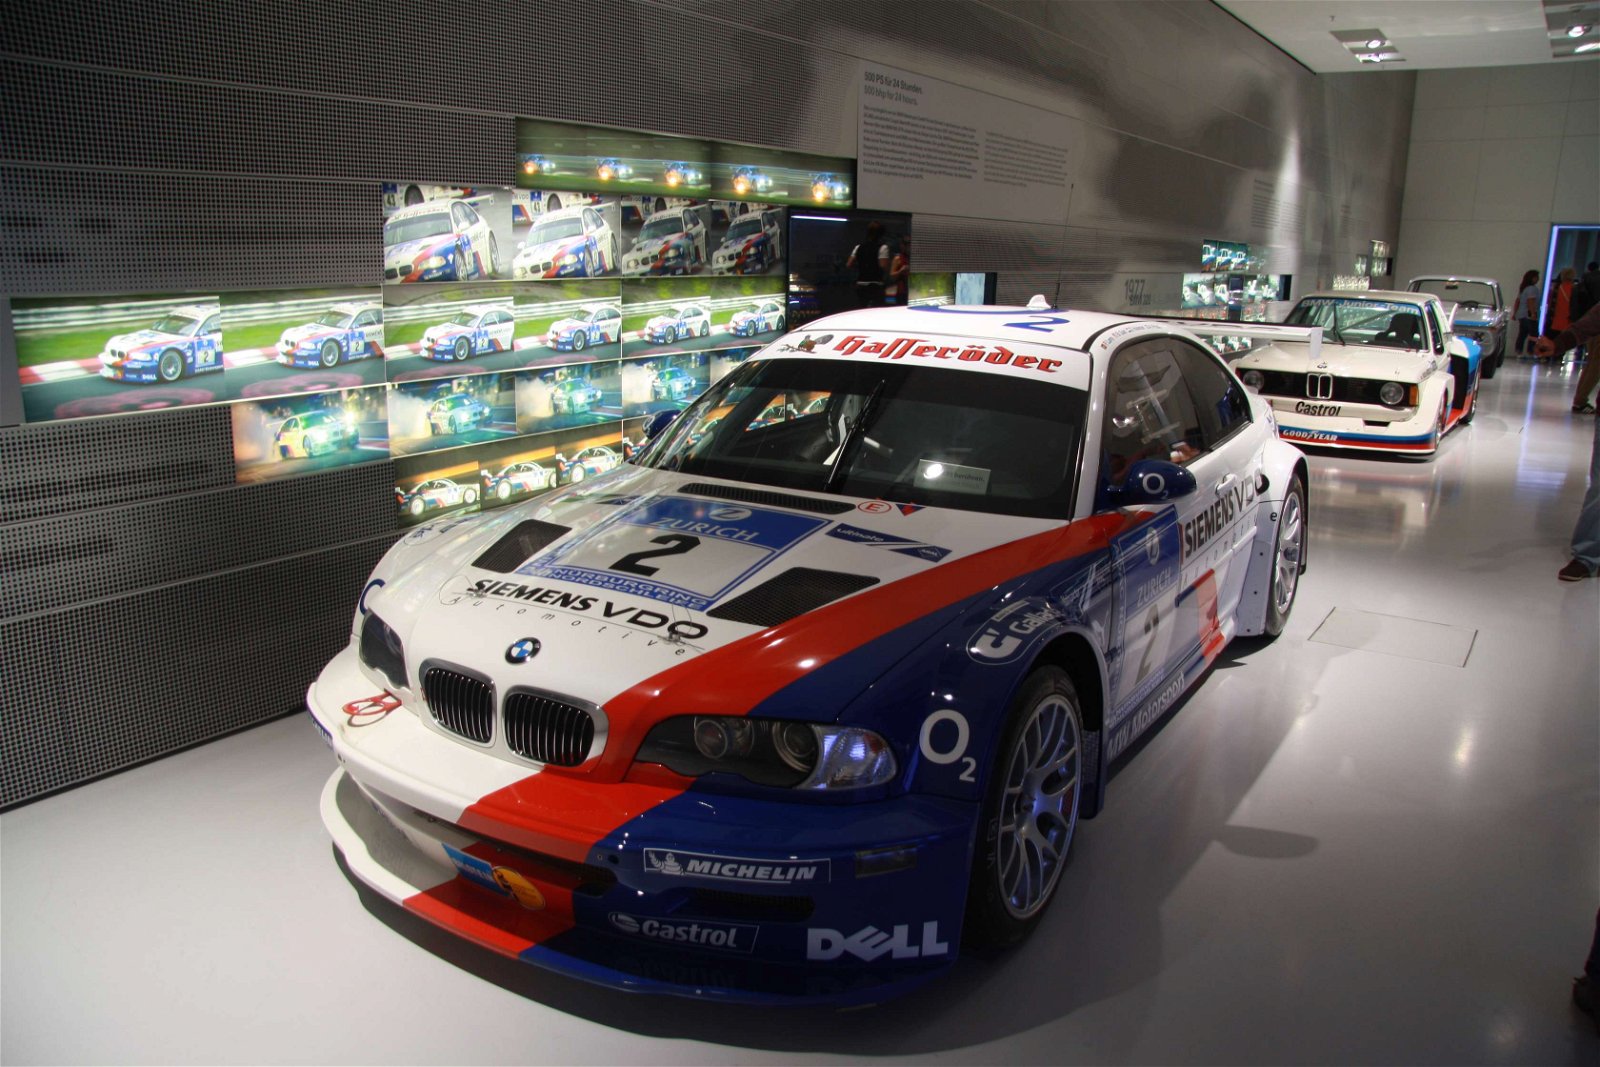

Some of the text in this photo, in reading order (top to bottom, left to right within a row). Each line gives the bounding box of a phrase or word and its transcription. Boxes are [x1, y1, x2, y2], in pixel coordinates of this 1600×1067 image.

[864, 71, 875, 82] 500
[876, 73, 884, 85] PS
[864, 84, 875, 96] 500
[1125, 278, 1145, 301] 1977
[1295, 401, 1341, 417] Castrol
[865, 502, 885, 512] E
[649, 517, 760, 542] ZURICH
[837, 527, 884, 542] ultimate
[1185, 490, 1234, 559] SIEMENS
[608, 532, 701, 577] 2
[1137, 566, 1171, 608] ZURICH
[467, 579, 709, 639] SIEMENS VDO
[1135, 602, 1160, 686] 2
[1131, 671, 1184, 736] Motorsport
[687, 858, 817, 881] MICHELIN
[641, 919, 737, 948] Castrol
[807, 920, 948, 962] DELL
